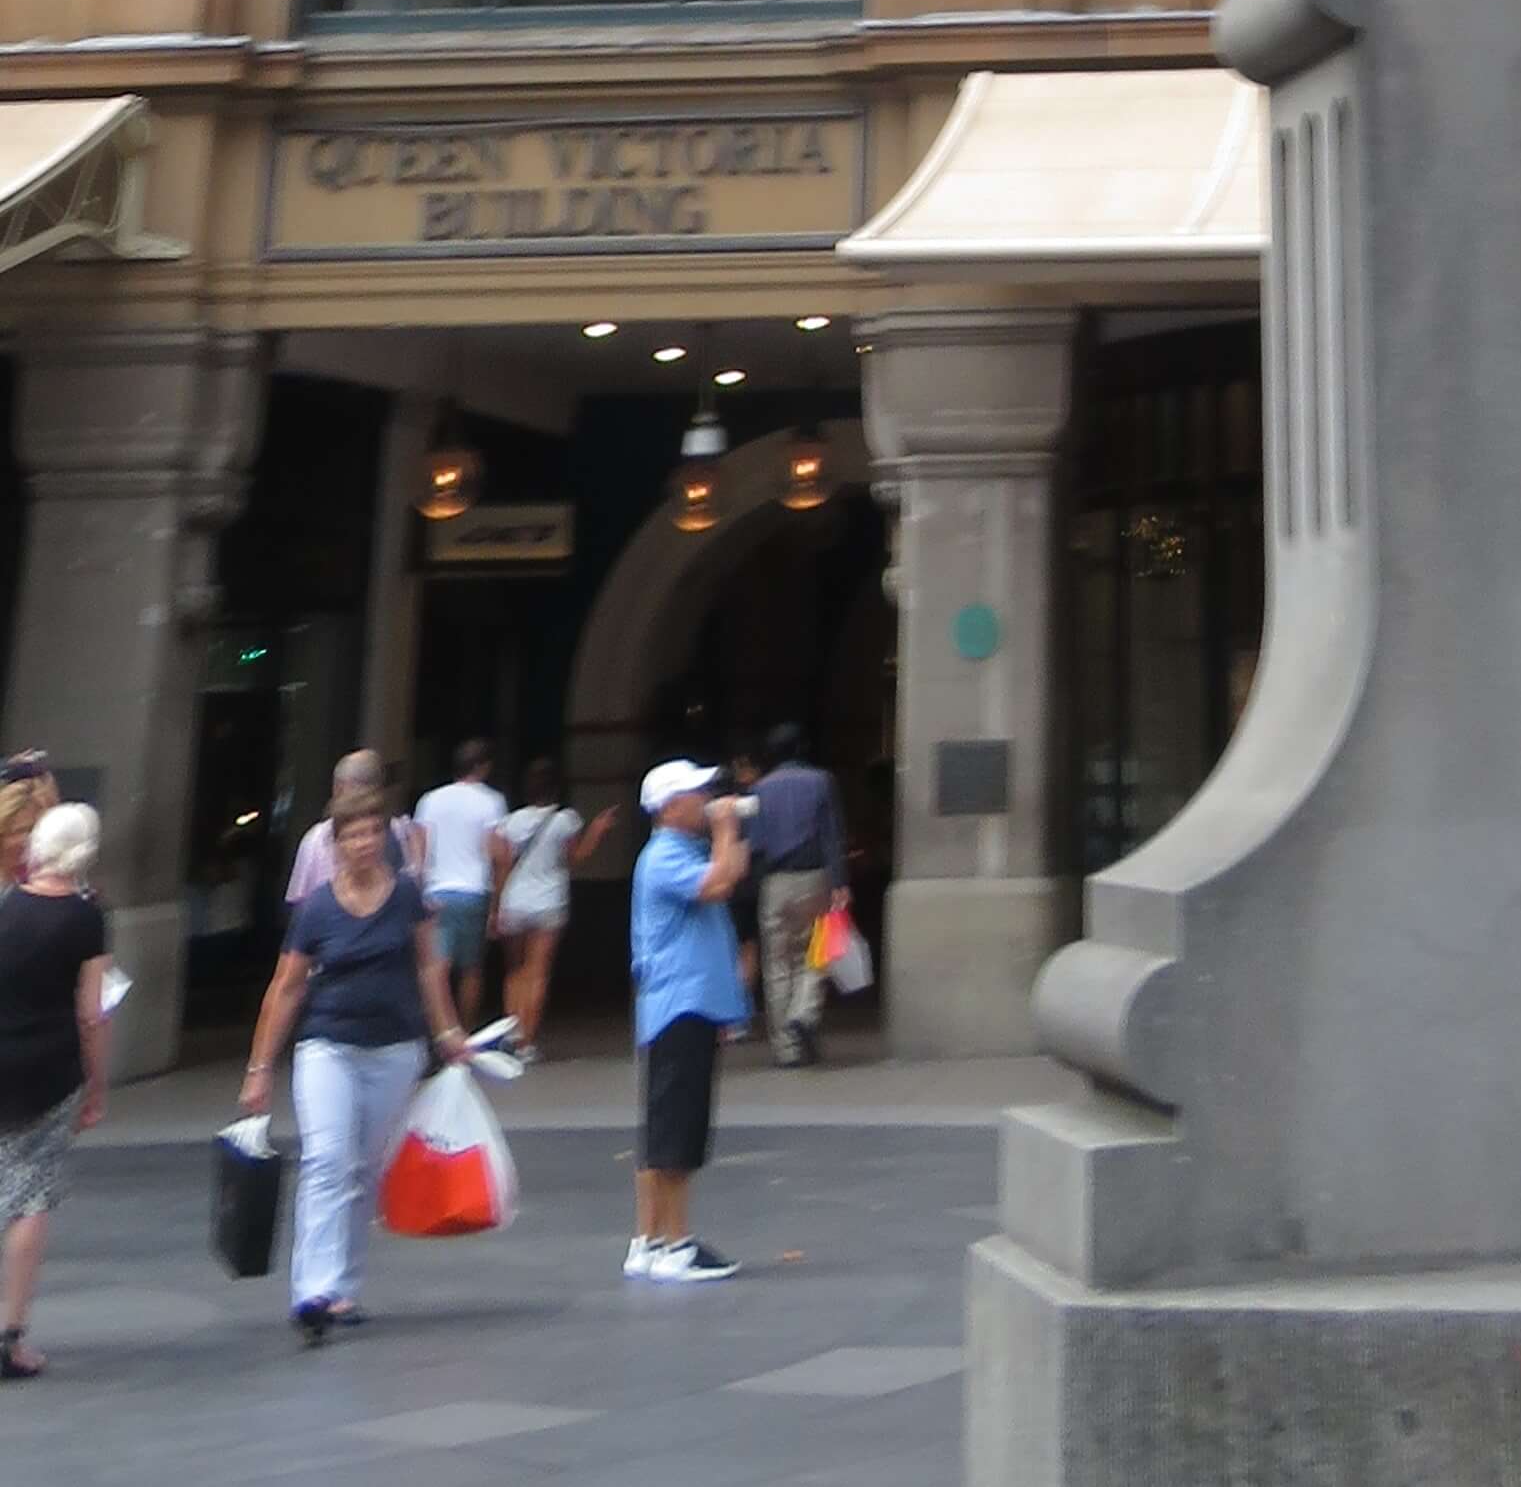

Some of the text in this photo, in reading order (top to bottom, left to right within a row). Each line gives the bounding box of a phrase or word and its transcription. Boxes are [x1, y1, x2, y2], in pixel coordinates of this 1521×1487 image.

[308, 125, 832, 191] QUEEN VICTORIA
[422, 185, 706, 240] BUILDING
